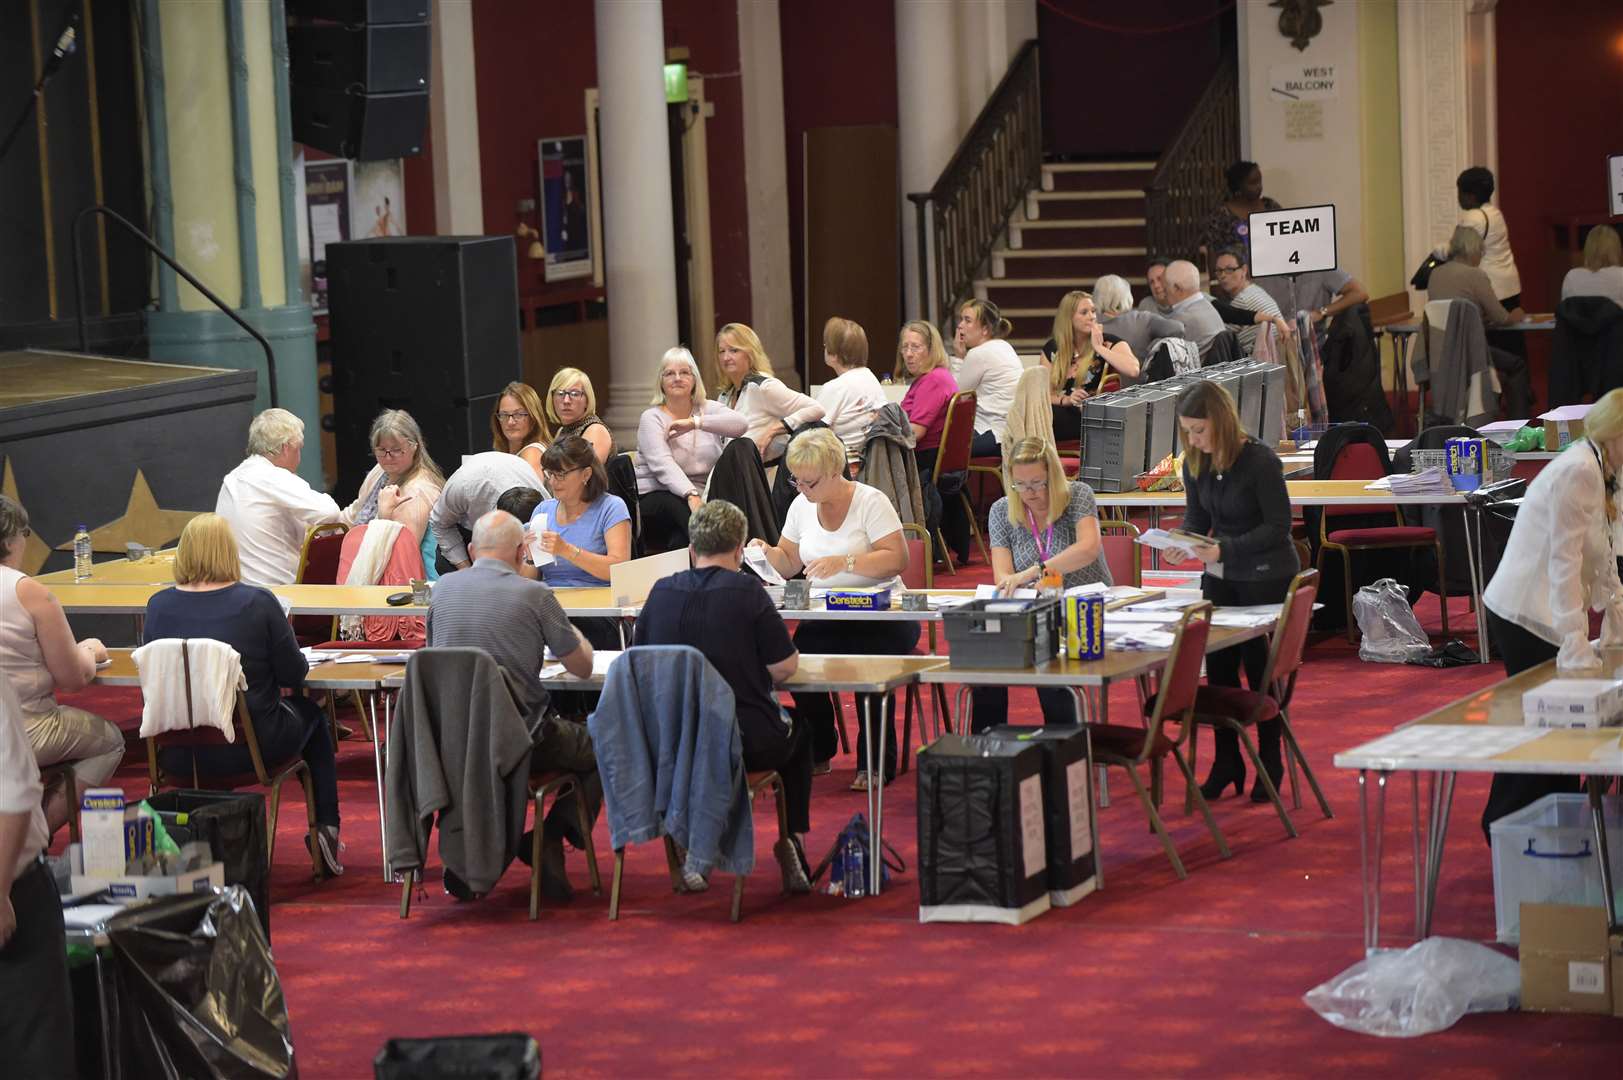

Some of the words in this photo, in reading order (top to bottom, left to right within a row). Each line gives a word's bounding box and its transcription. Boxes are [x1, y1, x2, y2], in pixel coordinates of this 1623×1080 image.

[1303, 67, 1334, 77] WEST
[1285, 81, 1335, 91] BALCONY
[1266, 218, 1320, 236] TEAM
[1288, 250, 1300, 265] 4
